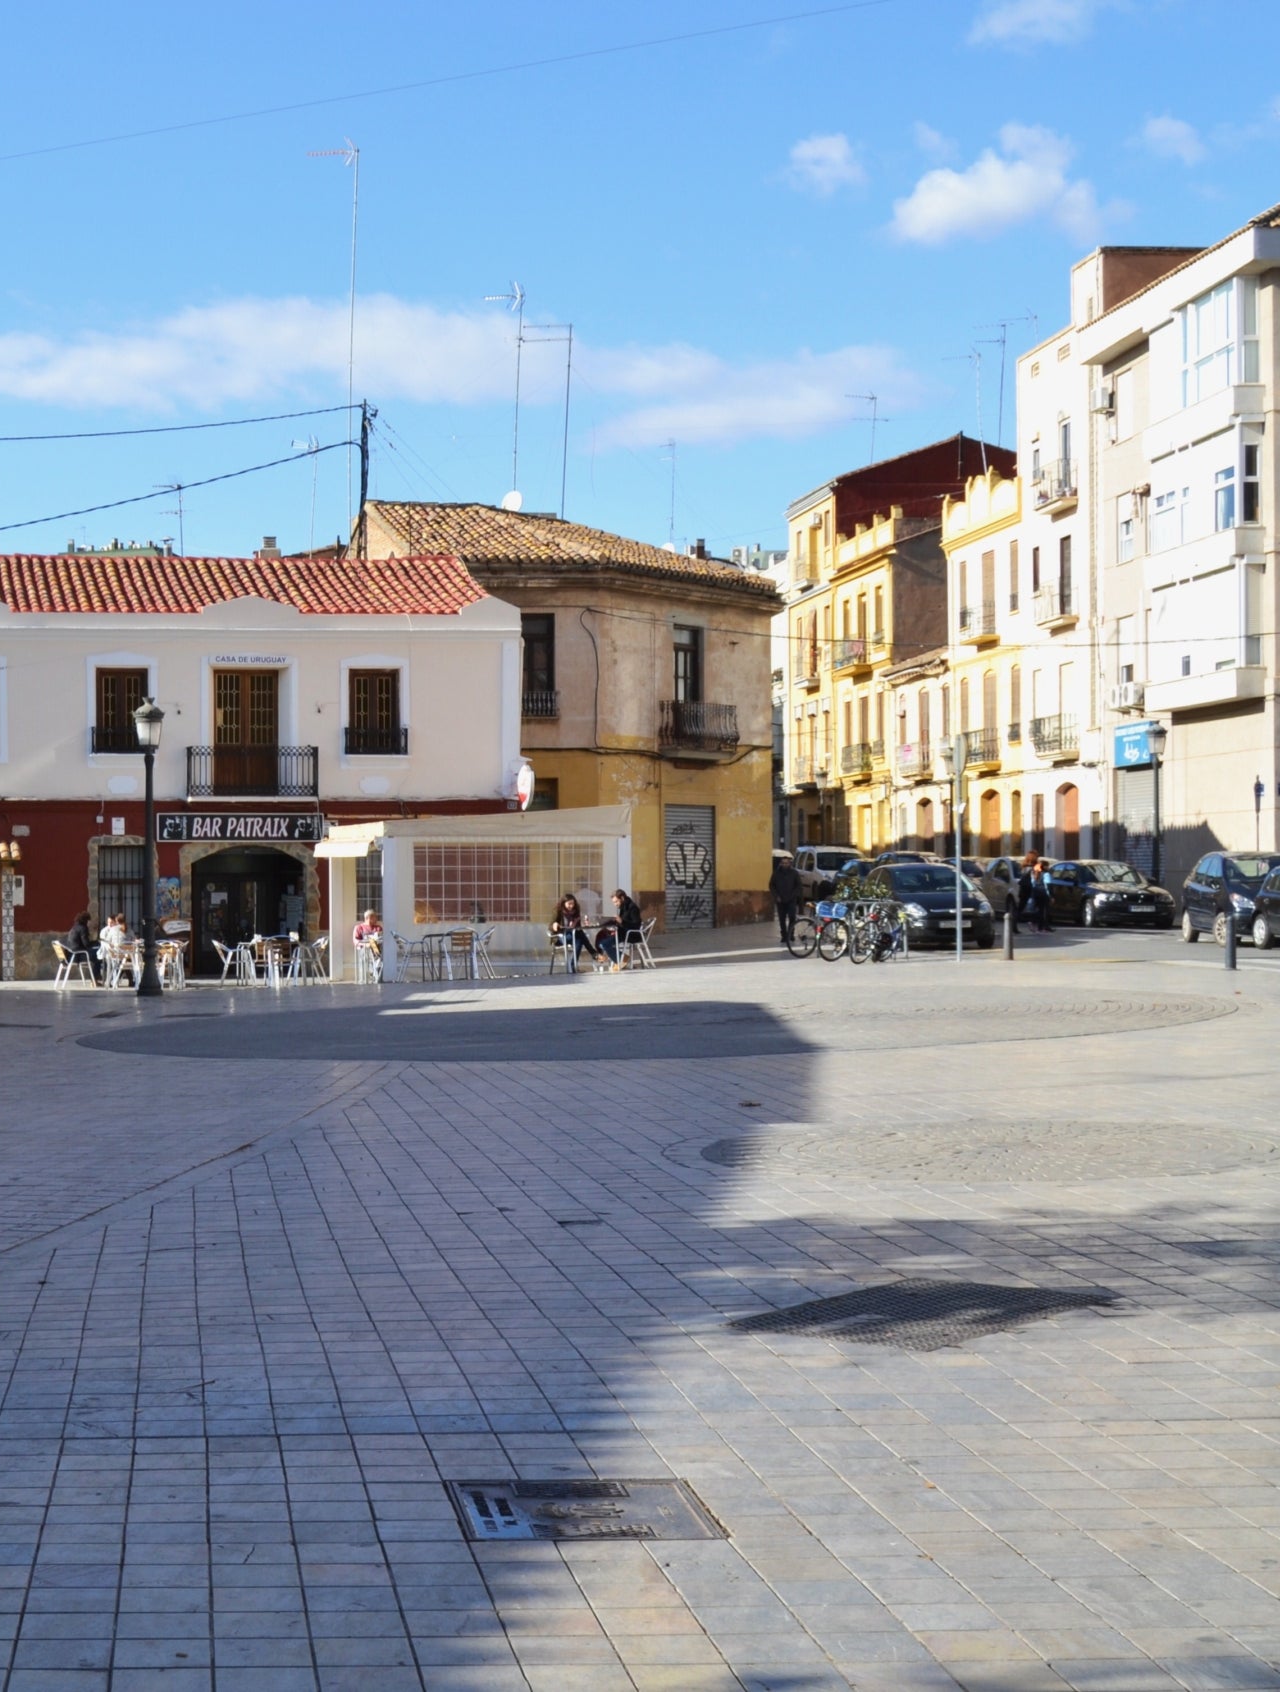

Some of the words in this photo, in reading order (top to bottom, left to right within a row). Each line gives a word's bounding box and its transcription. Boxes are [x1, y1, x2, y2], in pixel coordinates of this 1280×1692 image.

[215, 655, 238, 663] CASA
[250, 656, 287, 664] URUGUAY
[192, 816, 222, 838] BAR
[226, 816, 290, 838] PATRAIX
